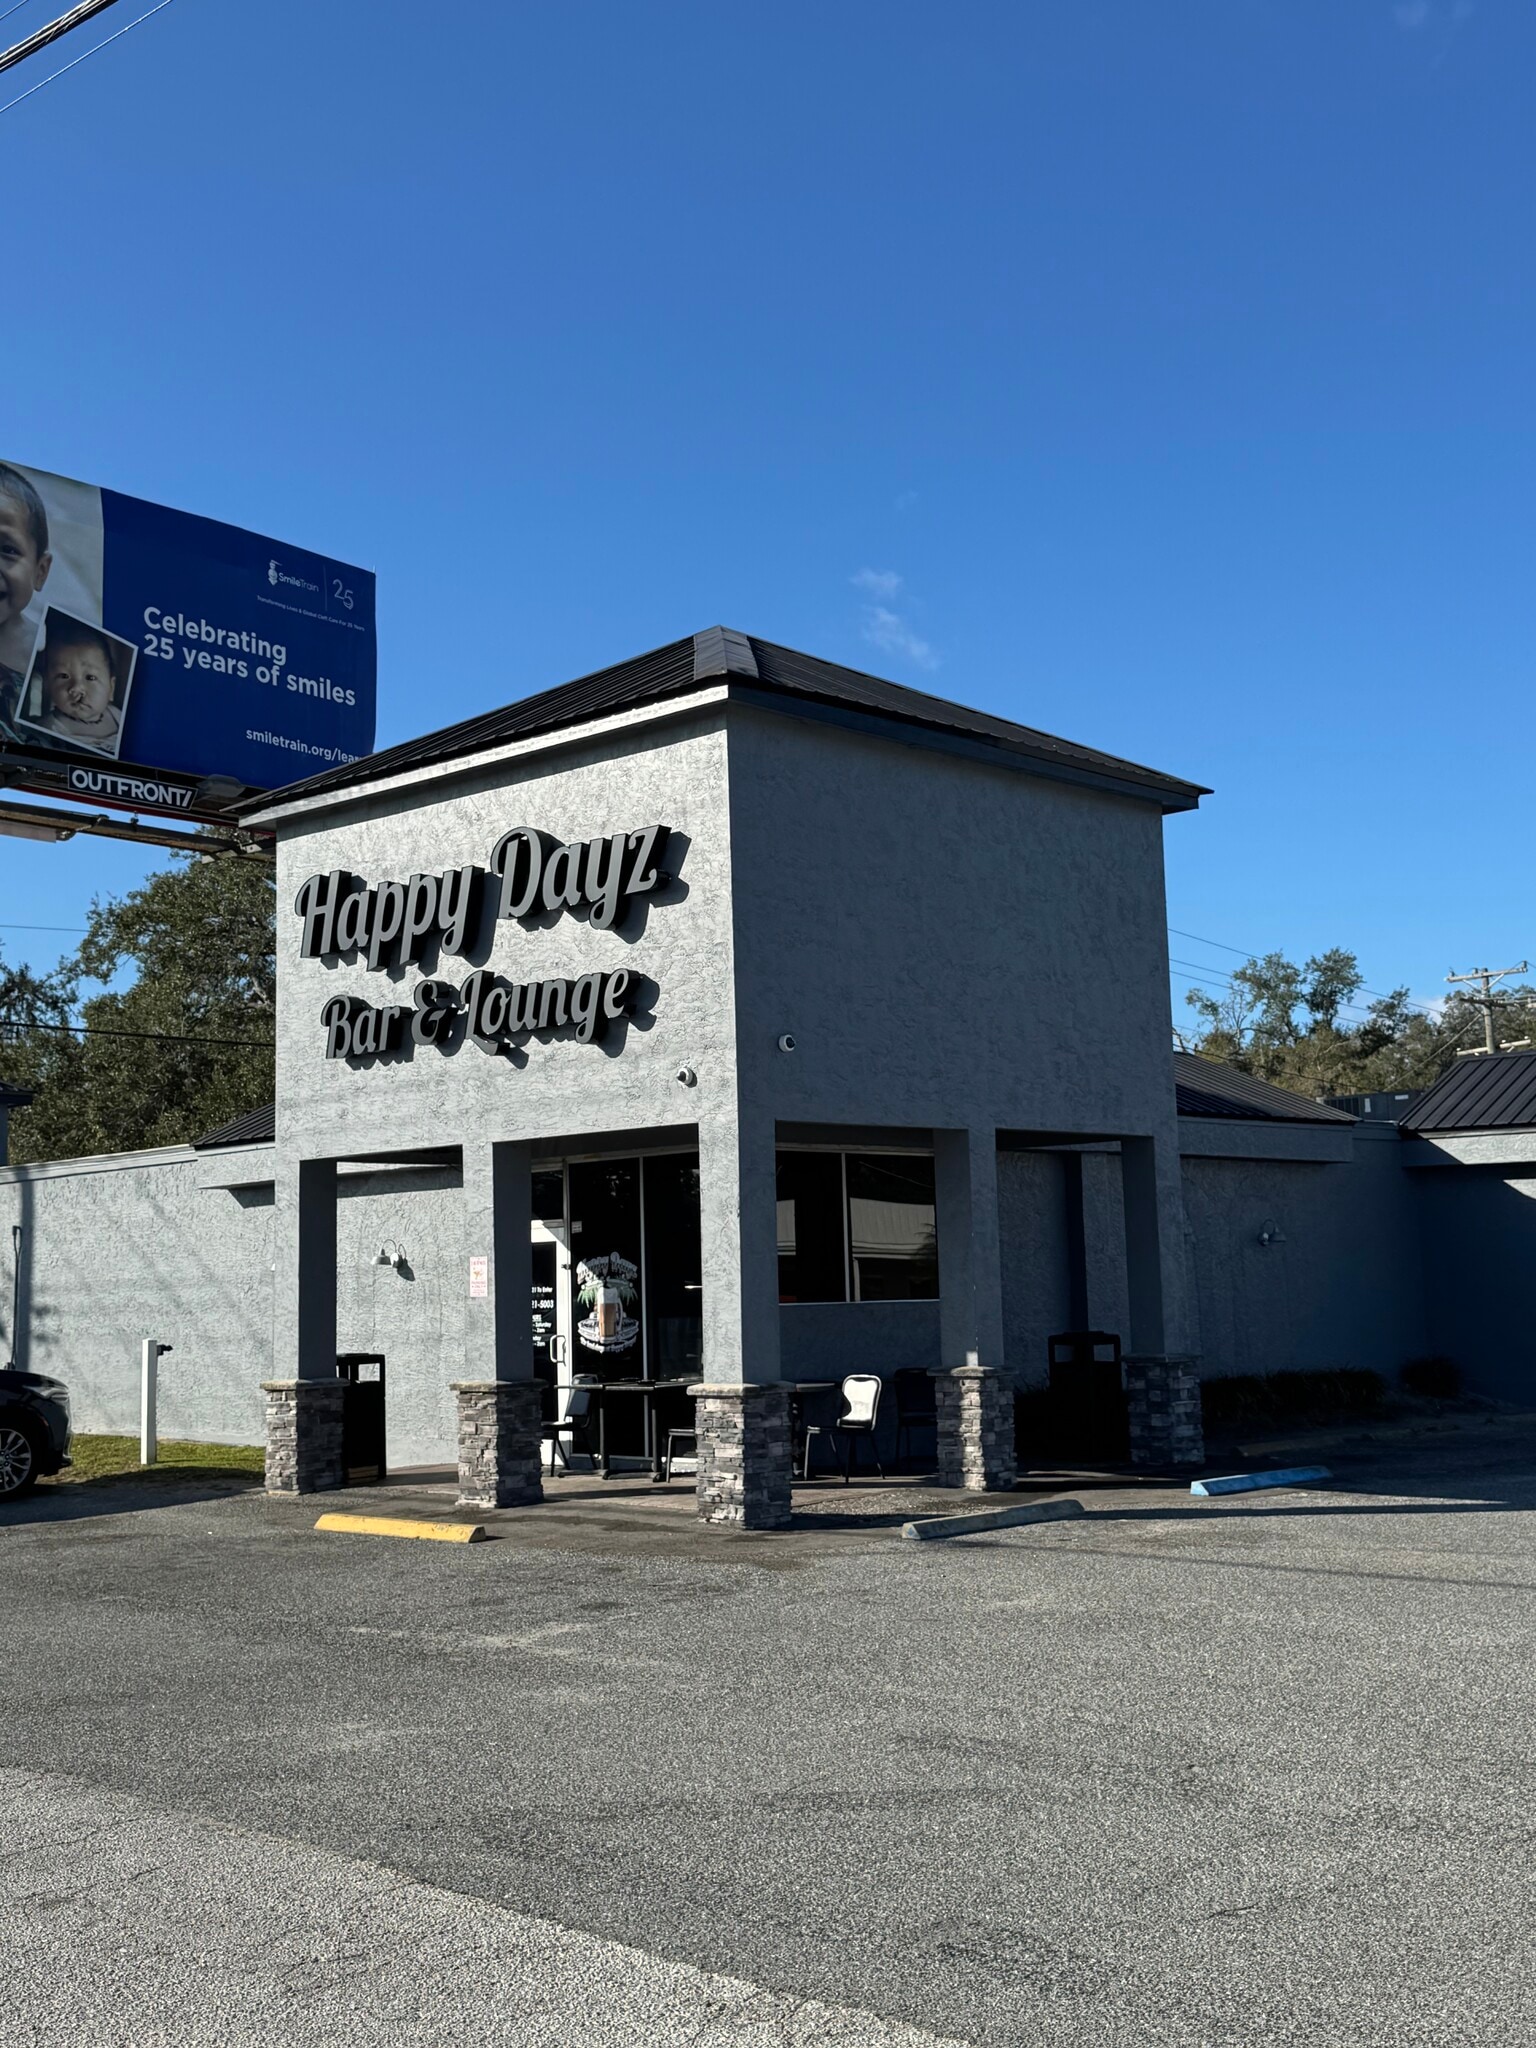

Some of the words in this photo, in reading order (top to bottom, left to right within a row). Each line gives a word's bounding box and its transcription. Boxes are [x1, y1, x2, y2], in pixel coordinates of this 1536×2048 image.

[332, 578, 354, 610] 25
[143, 606, 287, 666] Celebrating
[143, 634, 175, 661] 25
[182, 646, 249, 679] years
[255, 665, 281, 687] of
[286, 673, 356, 706] smiles
[295, 865, 482, 971] Happy
[490, 825, 668, 930] Dayz
[320, 994, 402, 1059] Bar
[411, 979, 450, 1046] &
[460, 968, 634, 1056] Lounge
